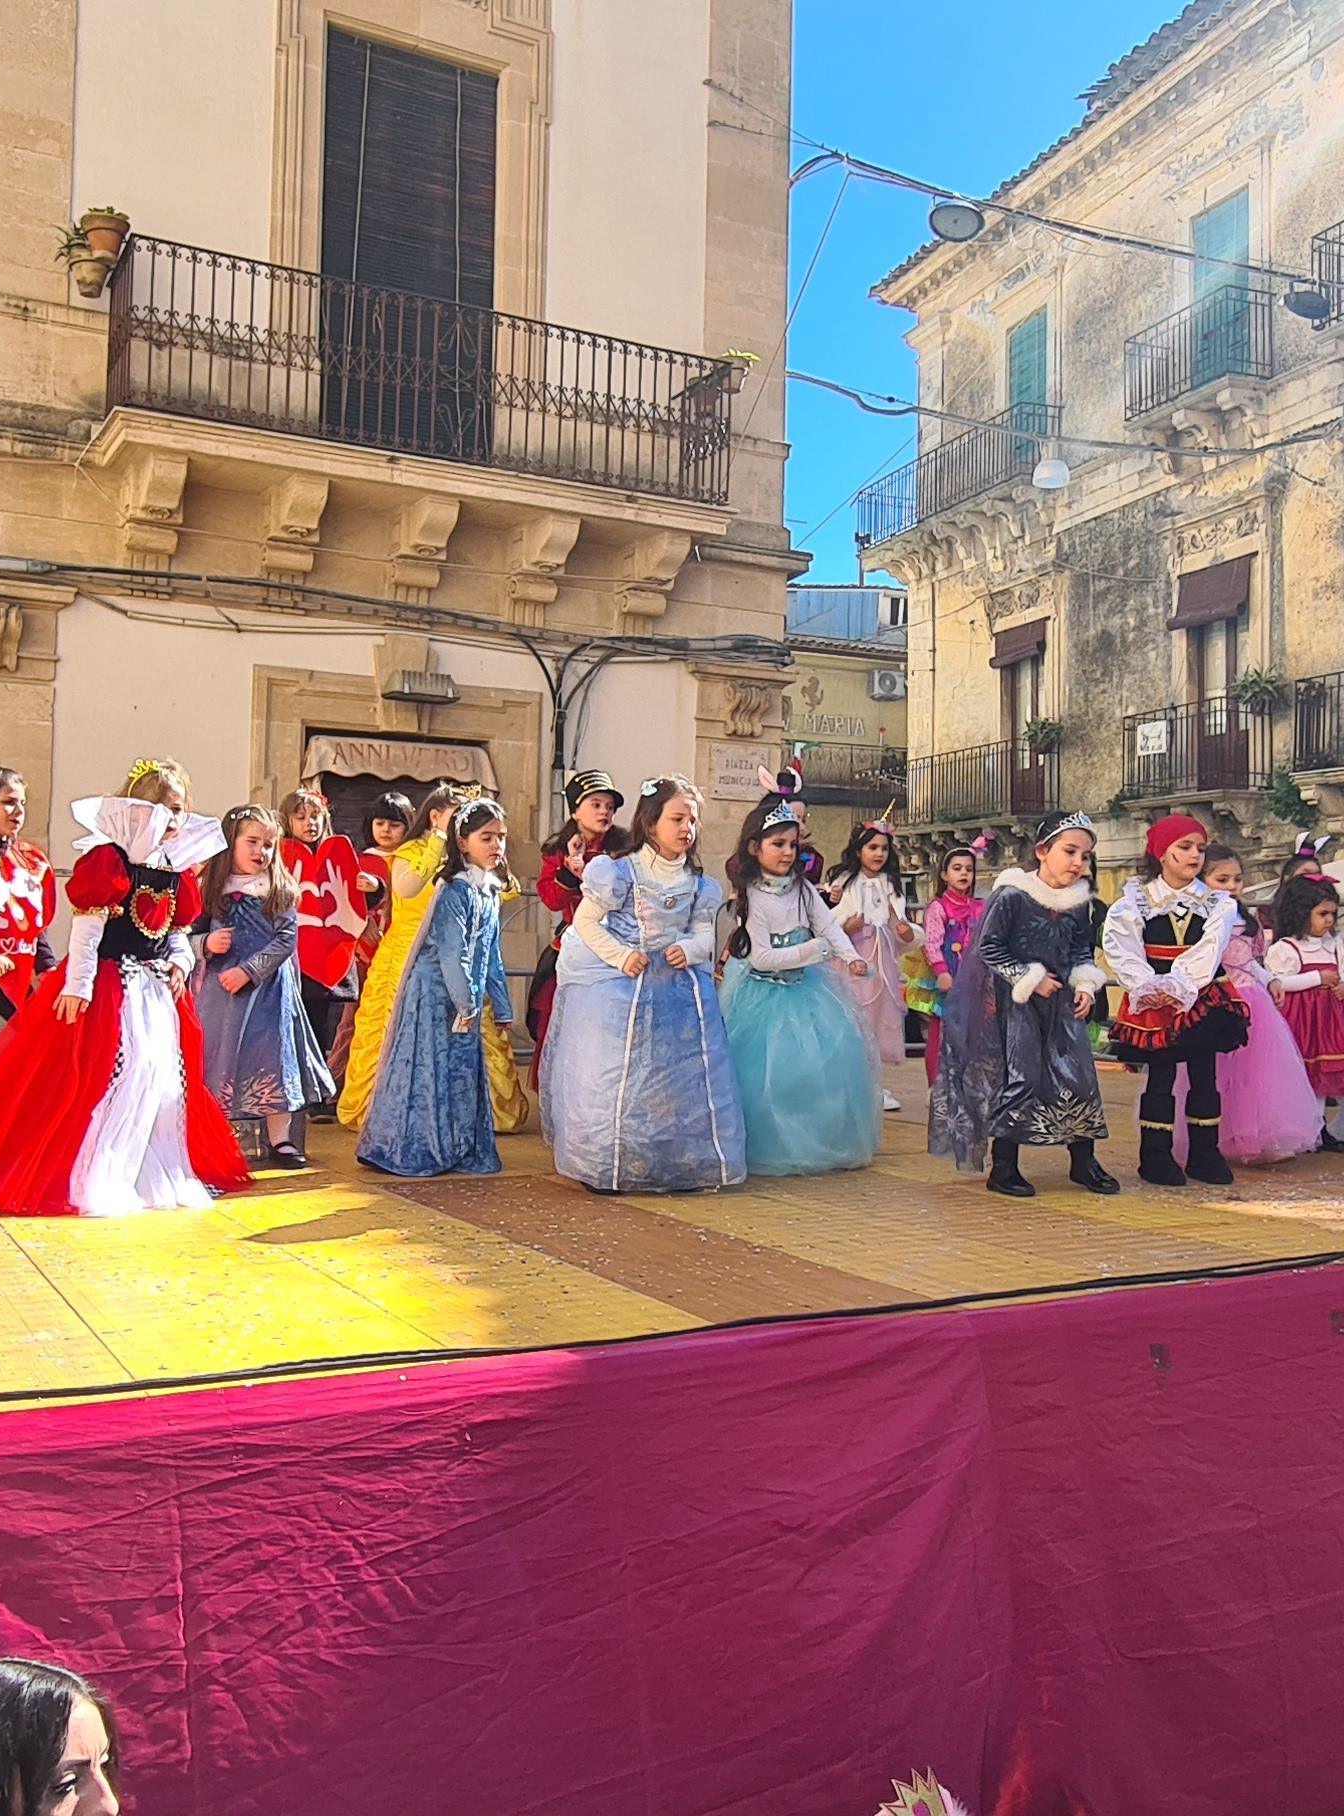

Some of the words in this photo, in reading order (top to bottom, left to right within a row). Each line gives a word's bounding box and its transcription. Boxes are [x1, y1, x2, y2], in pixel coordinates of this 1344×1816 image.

[803, 712, 866, 737] MARIA
[332, 741, 392, 766] ANNI
[400, 745, 479, 775] VERDI
[725, 759, 754, 770] PIAZZA
